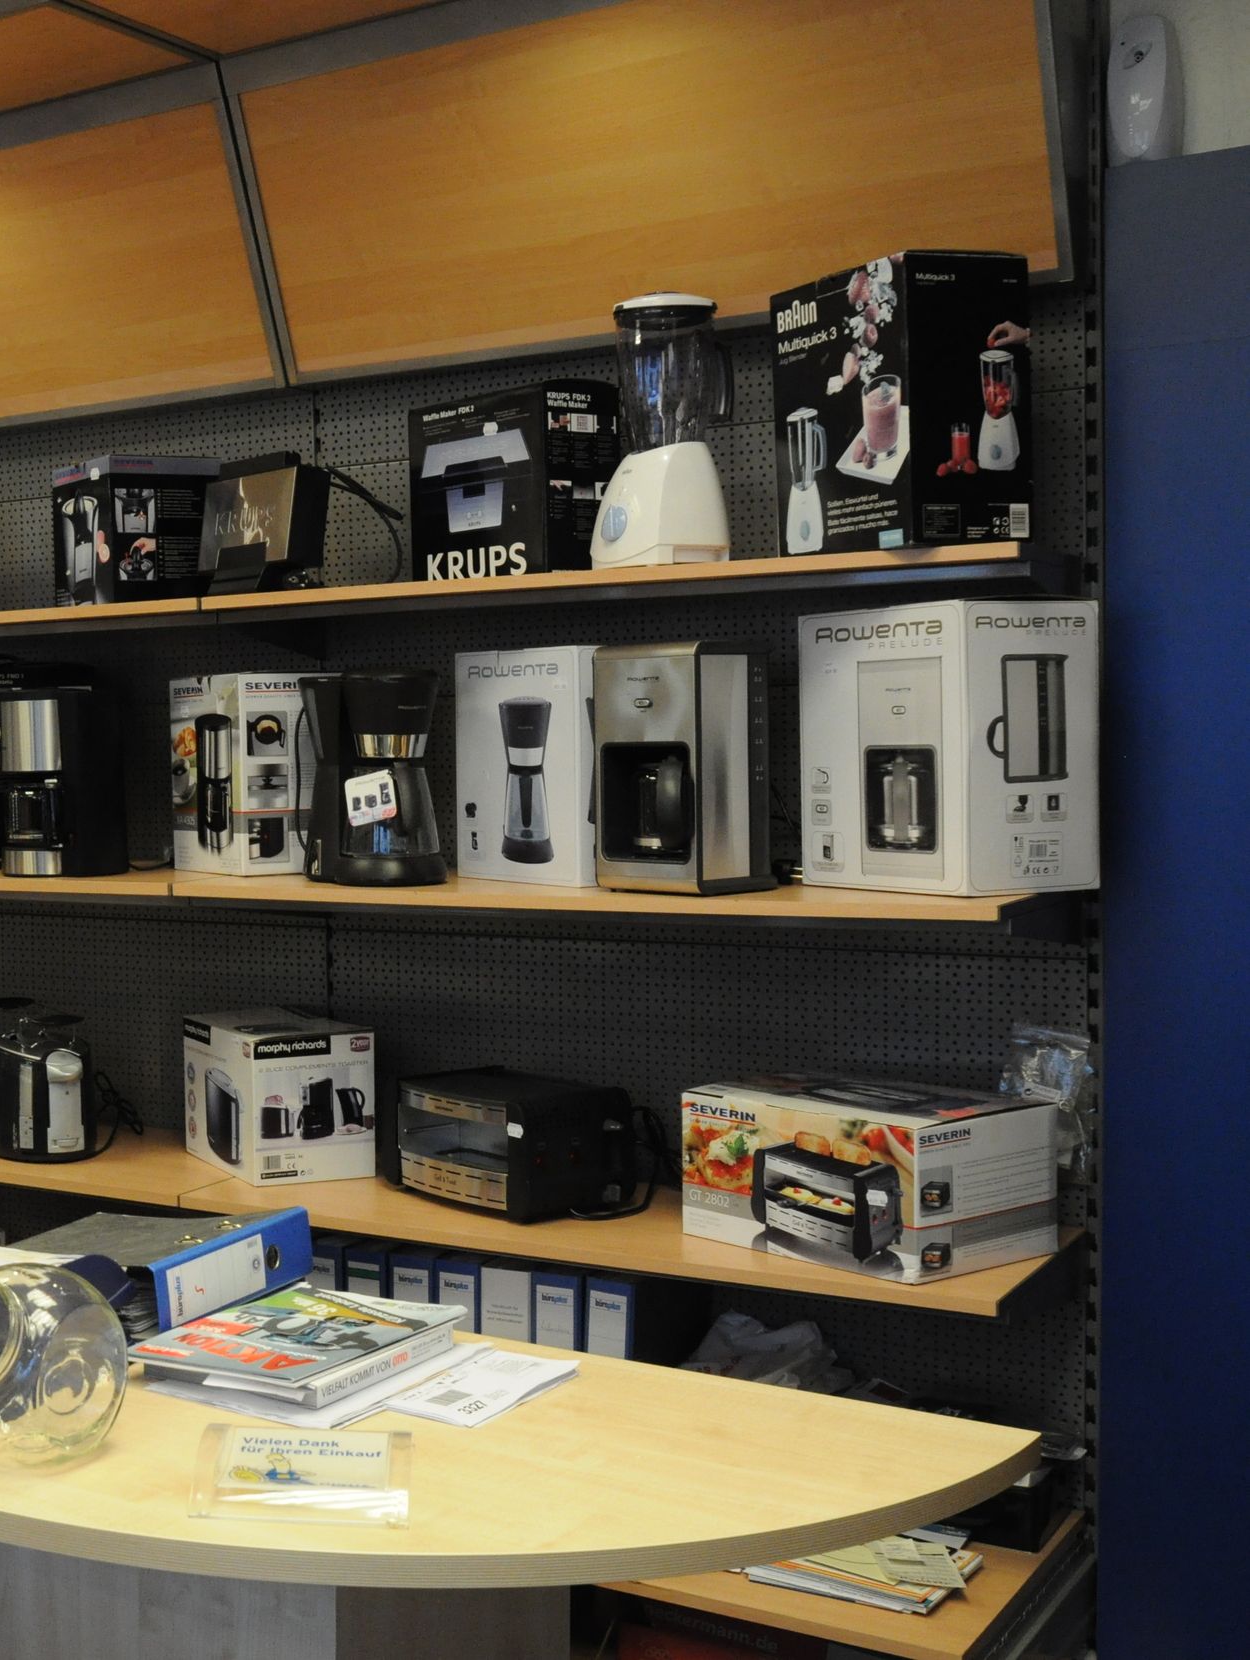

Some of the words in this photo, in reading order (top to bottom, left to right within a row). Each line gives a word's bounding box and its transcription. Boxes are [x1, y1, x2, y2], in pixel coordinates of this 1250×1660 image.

[776, 299, 818, 334] BRAUN
[778, 330, 829, 355] Multiquick
[830, 326, 838, 340] 3
[547, 391, 571, 400] KRUPS
[547, 400, 568, 408] Waffle
[568, 401, 589, 409] Maker
[422, 411, 440, 422] Waffle
[440, 409, 457, 419] Maker
[458, 406, 471, 415] FDK
[427, 541, 527, 582] KRUPS
[868, 637, 943, 649] PRELUDE
[173, 685, 204, 696] SEVERIN
[245, 680, 301, 691] SEVERI
[257, 1042, 291, 1055] morphy
[292, 1039, 327, 1051] richards
[689, 1102, 756, 1123] SEVERIN
[919, 1128, 972, 1146] SEVERIN
[689, 1188, 702, 1202] GT
[705, 1191, 730, 1208] 2802
[444, 1279, 469, 1291] büroplus
[175, 1276, 184, 1317] büroplus
[541, 1292, 568, 1305] büroplus
[307, 1300, 337, 1315] 36
[595, 1298, 621, 1311] büroplus
[173, 1332, 318, 1372] AKTION
[320, 1377, 349, 1398] VIELFALT
[349, 1366, 375, 1385] KOMMT
[375, 1359, 391, 1374] VON
[392, 1351, 409, 1367] OTTO
[243, 1436, 294, 1446] Vielen
[299, 1439, 340, 1448] Dank
[241, 1445, 264, 1454] für
[270, 1447, 313, 1456] Ihren
[319, 1449, 382, 1458] Einkauf
